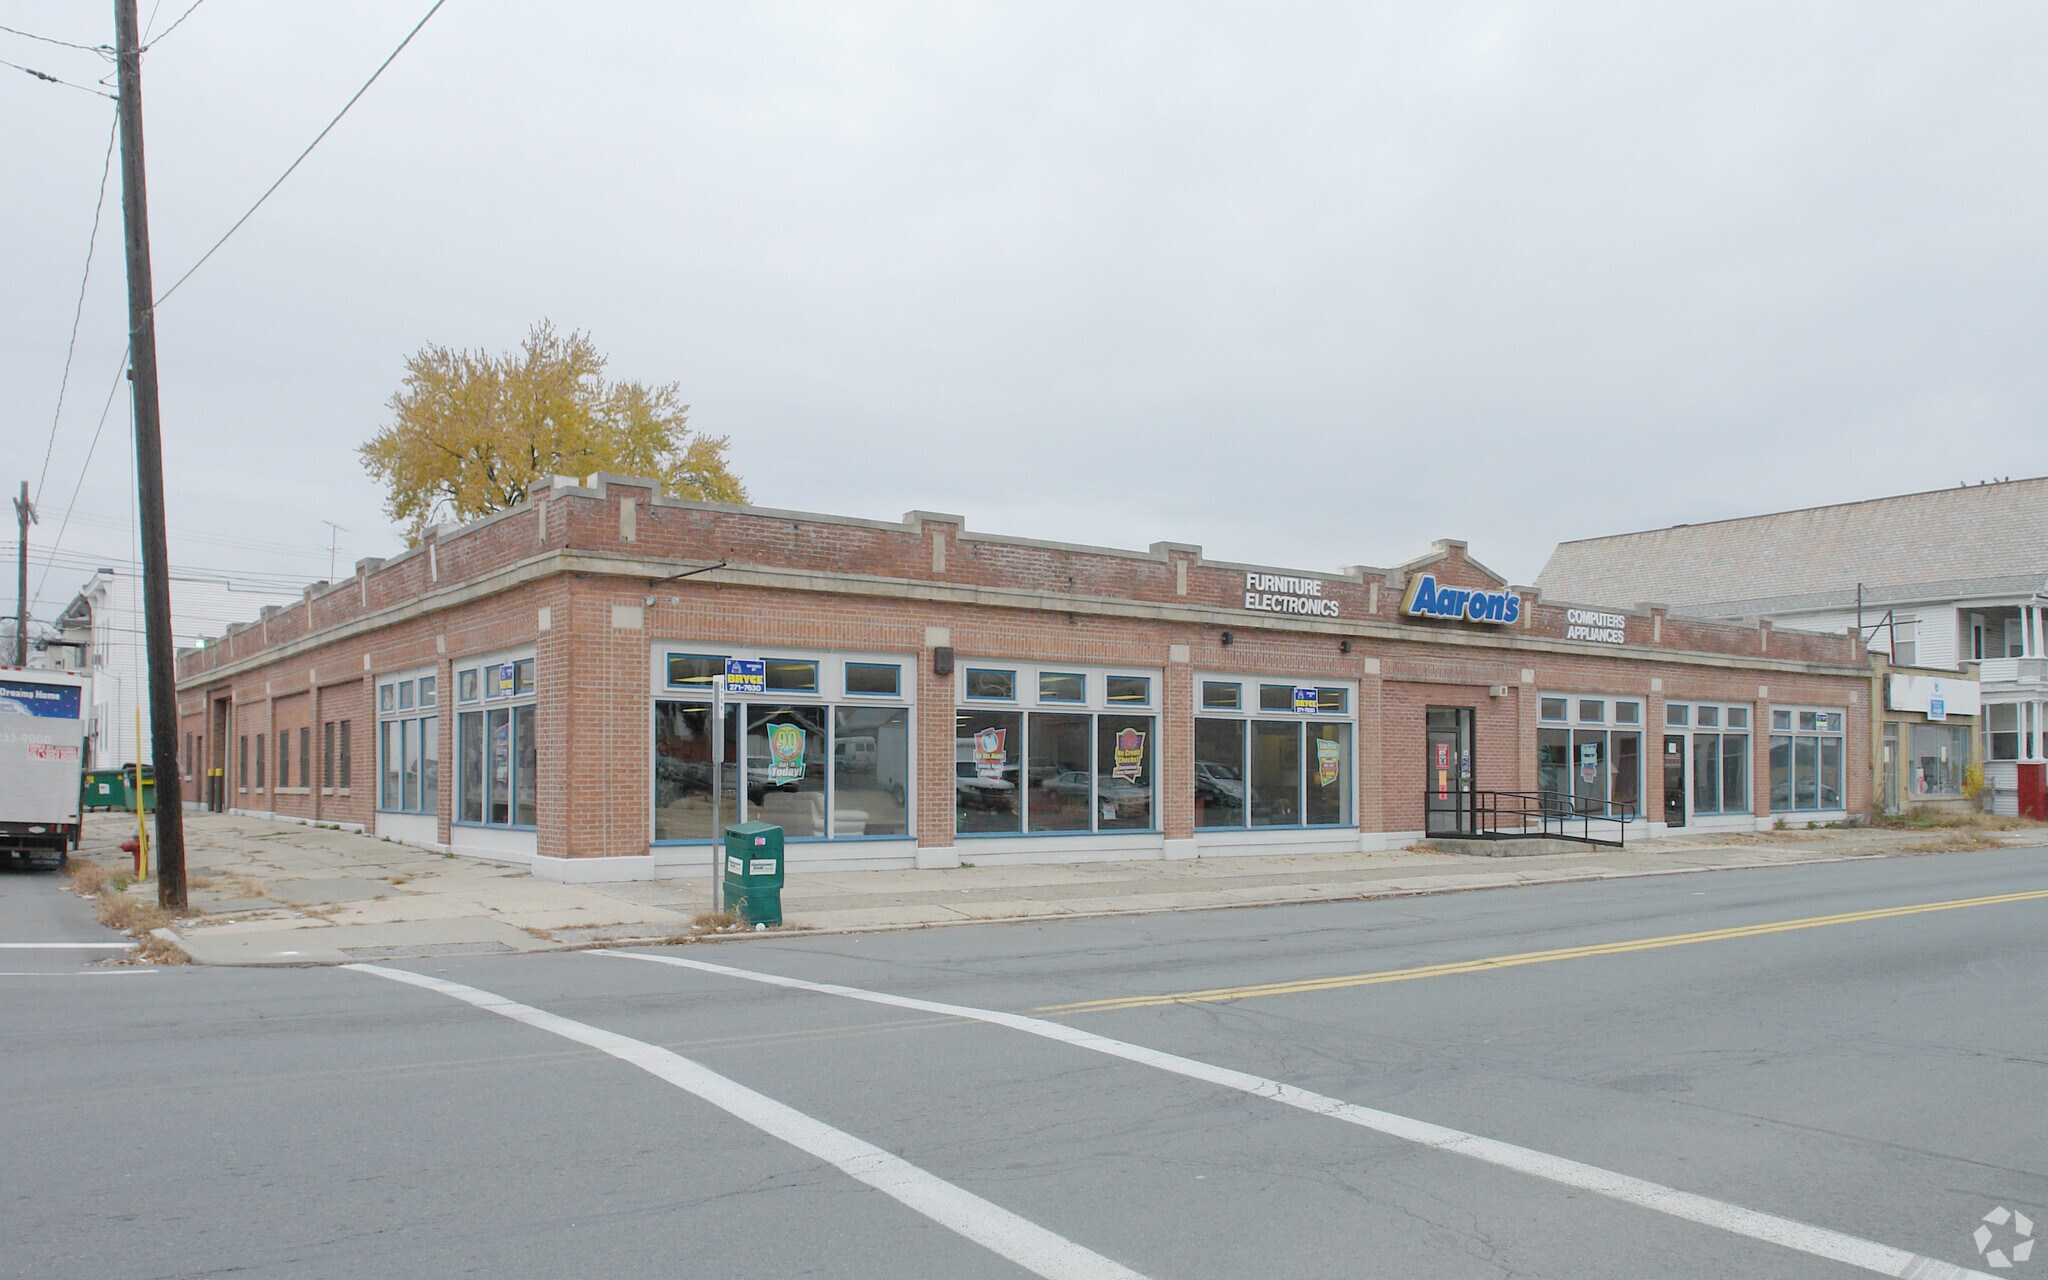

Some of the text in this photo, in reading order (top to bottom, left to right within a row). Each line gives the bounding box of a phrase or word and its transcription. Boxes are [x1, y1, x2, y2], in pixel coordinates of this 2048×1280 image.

[1246, 573, 1322, 597] FURNITURE
[1245, 592, 1340, 618] ELECTRONICS
[1410, 575, 1521, 624] Aaron's
[1567, 608, 1626, 629] COMPUTERS
[1566, 625, 1625, 644] APPLIANCES
[727, 673, 763, 685] BRYCE
[729, 684, 762, 692] 271-7630
[0, 688, 60, 700] Dreams Home
[0, 733, 51, 743] 33-9000
[778, 730, 798, 750] 90
[771, 766, 803, 777] Today!
